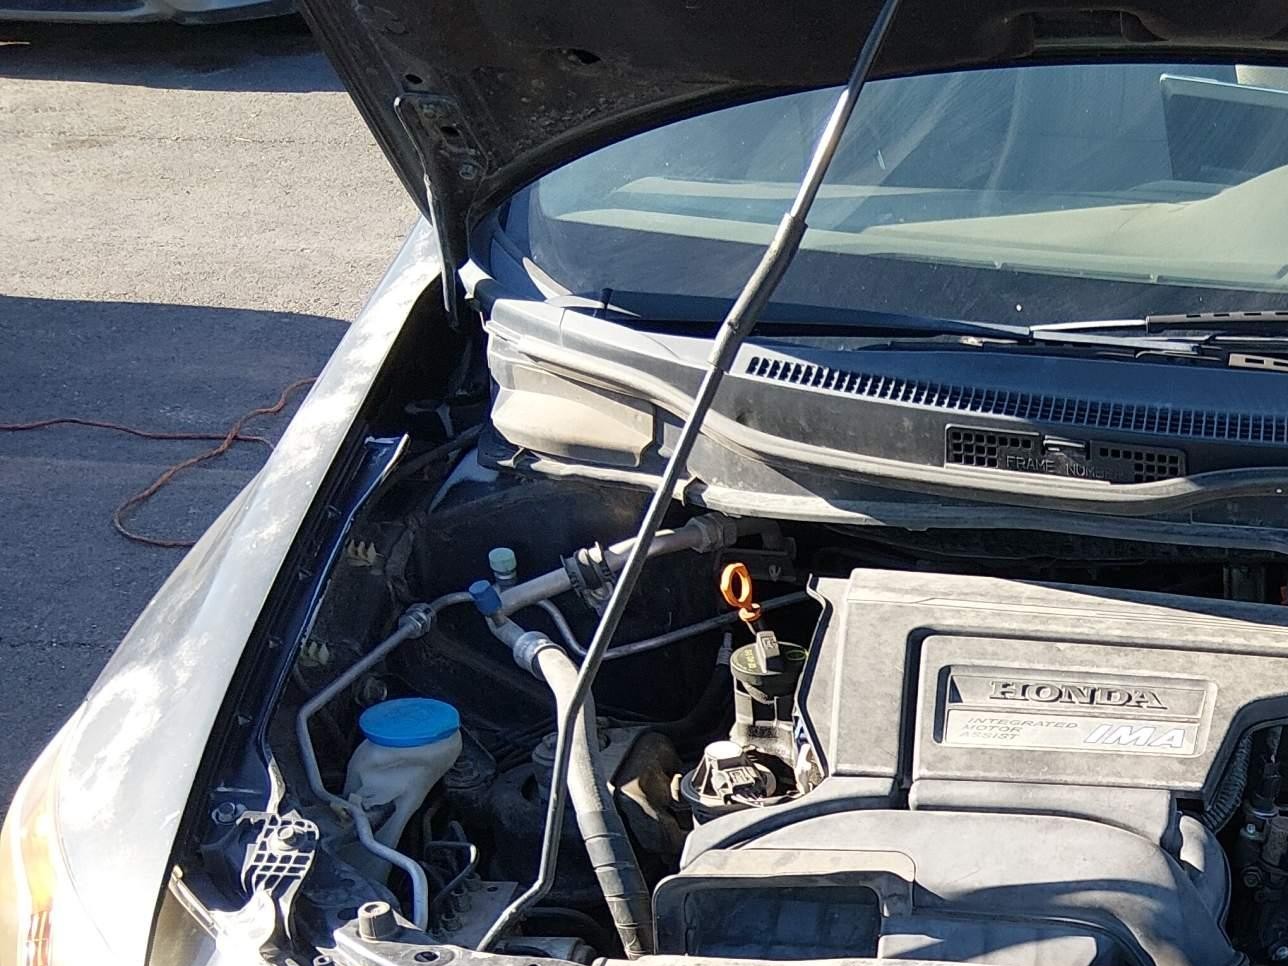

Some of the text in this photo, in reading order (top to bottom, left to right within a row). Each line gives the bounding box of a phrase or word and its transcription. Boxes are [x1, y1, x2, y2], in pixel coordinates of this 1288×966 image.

[1006, 455, 1055, 472] FRAME
[989, 681, 1168, 709] HONDA
[962, 724, 1024, 733] MOTOR
[967, 717, 1079, 729] INTEGRATED
[959, 731, 1018, 741] ASSIST
[1084, 725, 1186, 748] IMA
